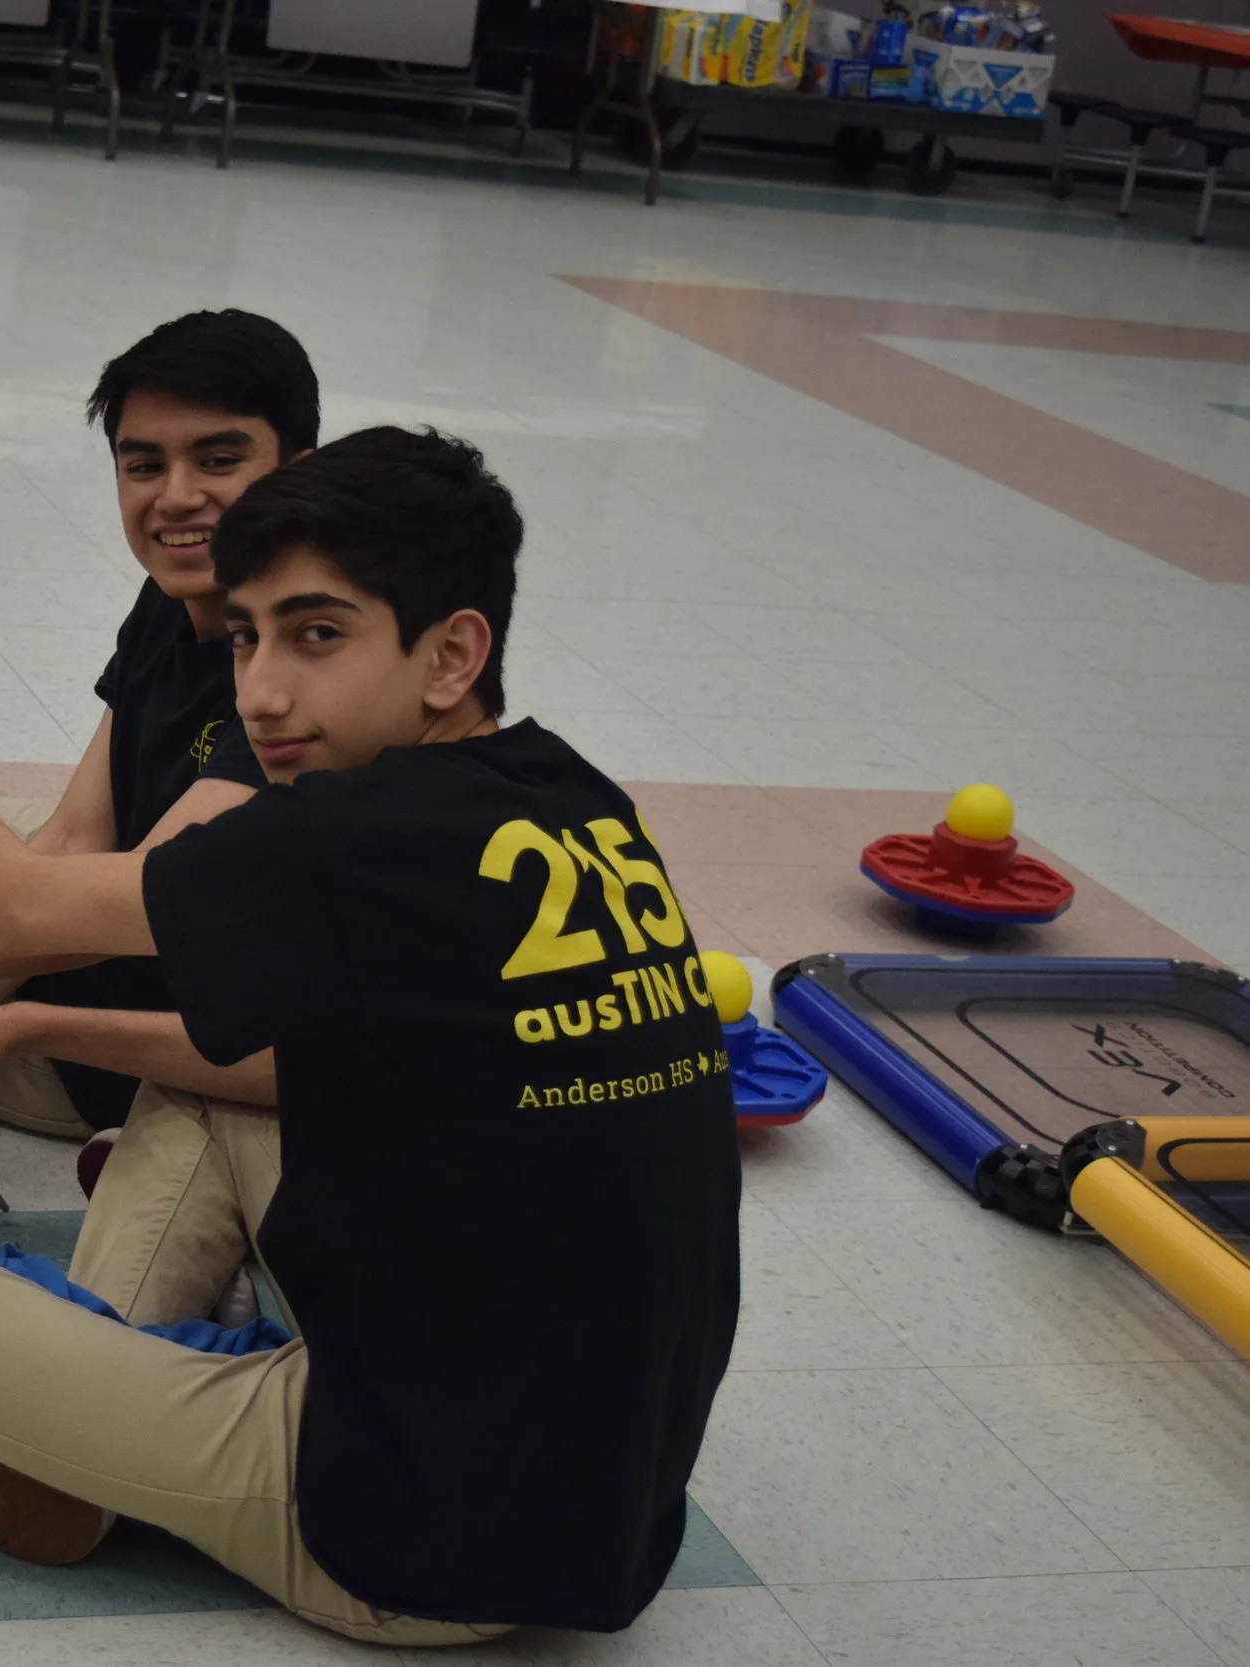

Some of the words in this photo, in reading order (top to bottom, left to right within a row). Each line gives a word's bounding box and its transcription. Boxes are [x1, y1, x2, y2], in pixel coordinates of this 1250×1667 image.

[745, 19, 767, 82] apkins
[478, 806, 686, 980] 215
[513, 962, 686, 1044] ausTIN
[684, 955, 713, 1008] C
[516, 1071, 666, 1109] Anderson
[669, 1058, 694, 1088] HS
[1071, 1023, 1182, 1097] VEX
[1125, 1022, 1236, 1098] COMPETITION
